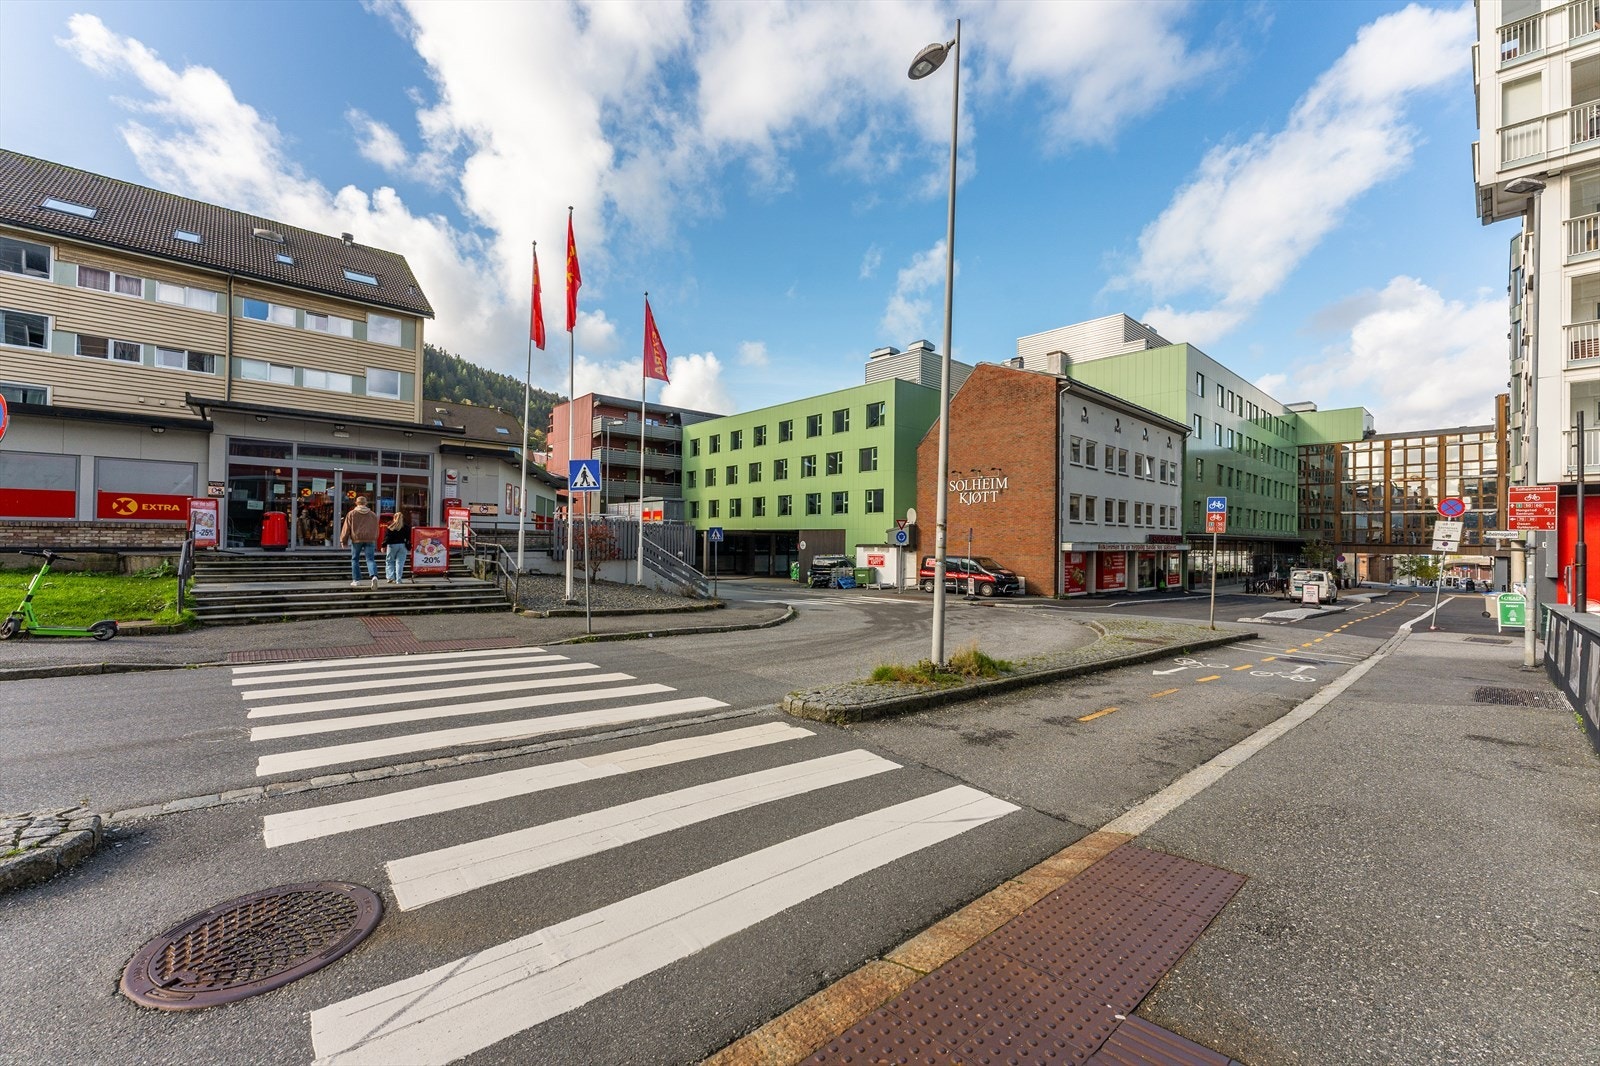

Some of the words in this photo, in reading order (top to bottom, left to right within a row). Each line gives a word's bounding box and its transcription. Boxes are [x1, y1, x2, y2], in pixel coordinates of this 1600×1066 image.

[949, 477, 1009, 492] SOLHEIM
[959, 490, 998, 506] KJØTT
[141, 503, 180, 511] EXTRA
[198, 528, 214, 537] -25%
[421, 556, 441, 564] -20%
